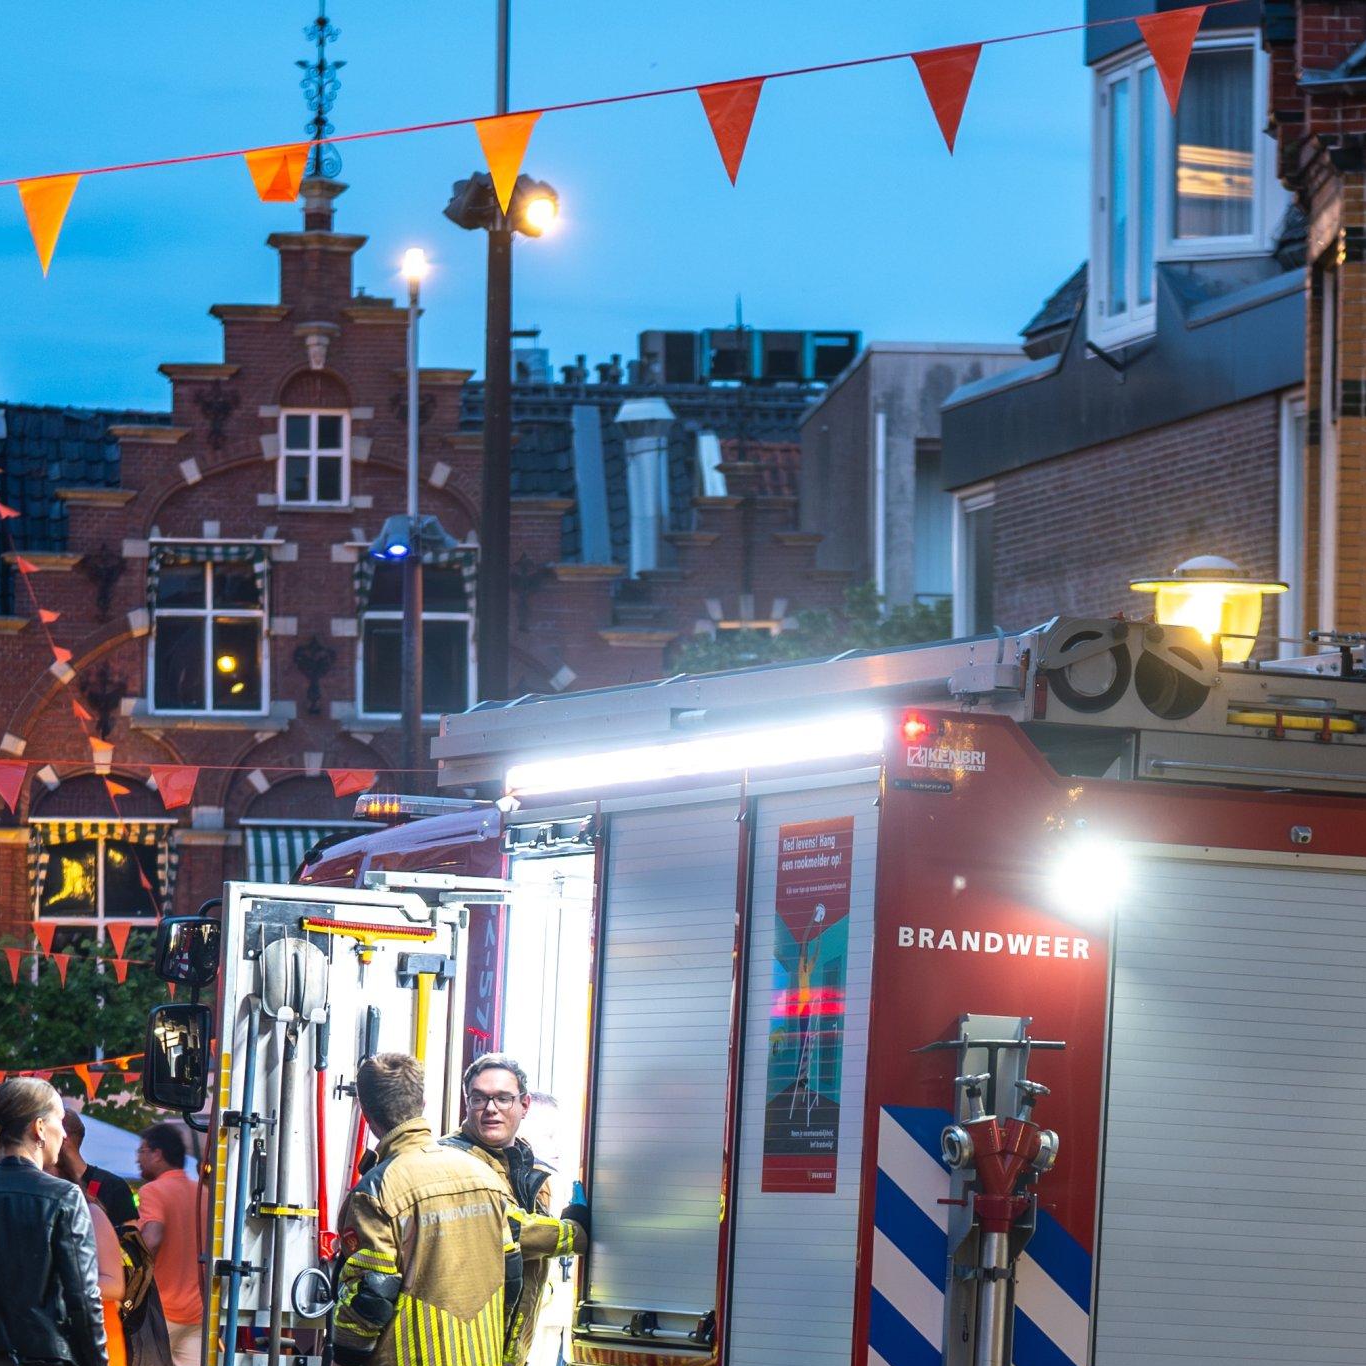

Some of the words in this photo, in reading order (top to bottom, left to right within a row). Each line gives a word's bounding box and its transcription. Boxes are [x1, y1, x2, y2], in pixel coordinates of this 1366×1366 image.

[928, 748, 986, 764] KENBRI
[783, 837, 795, 851] Red
[796, 835, 818, 850] levens!
[819, 834, 835, 849] Hang
[782, 860, 793, 871] een
[794, 853, 830, 869] rookmelder
[831, 852, 842, 869] op!
[898, 926, 1090, 959] BRANDWEER
[420, 1202, 494, 1228] BRANDWEER
